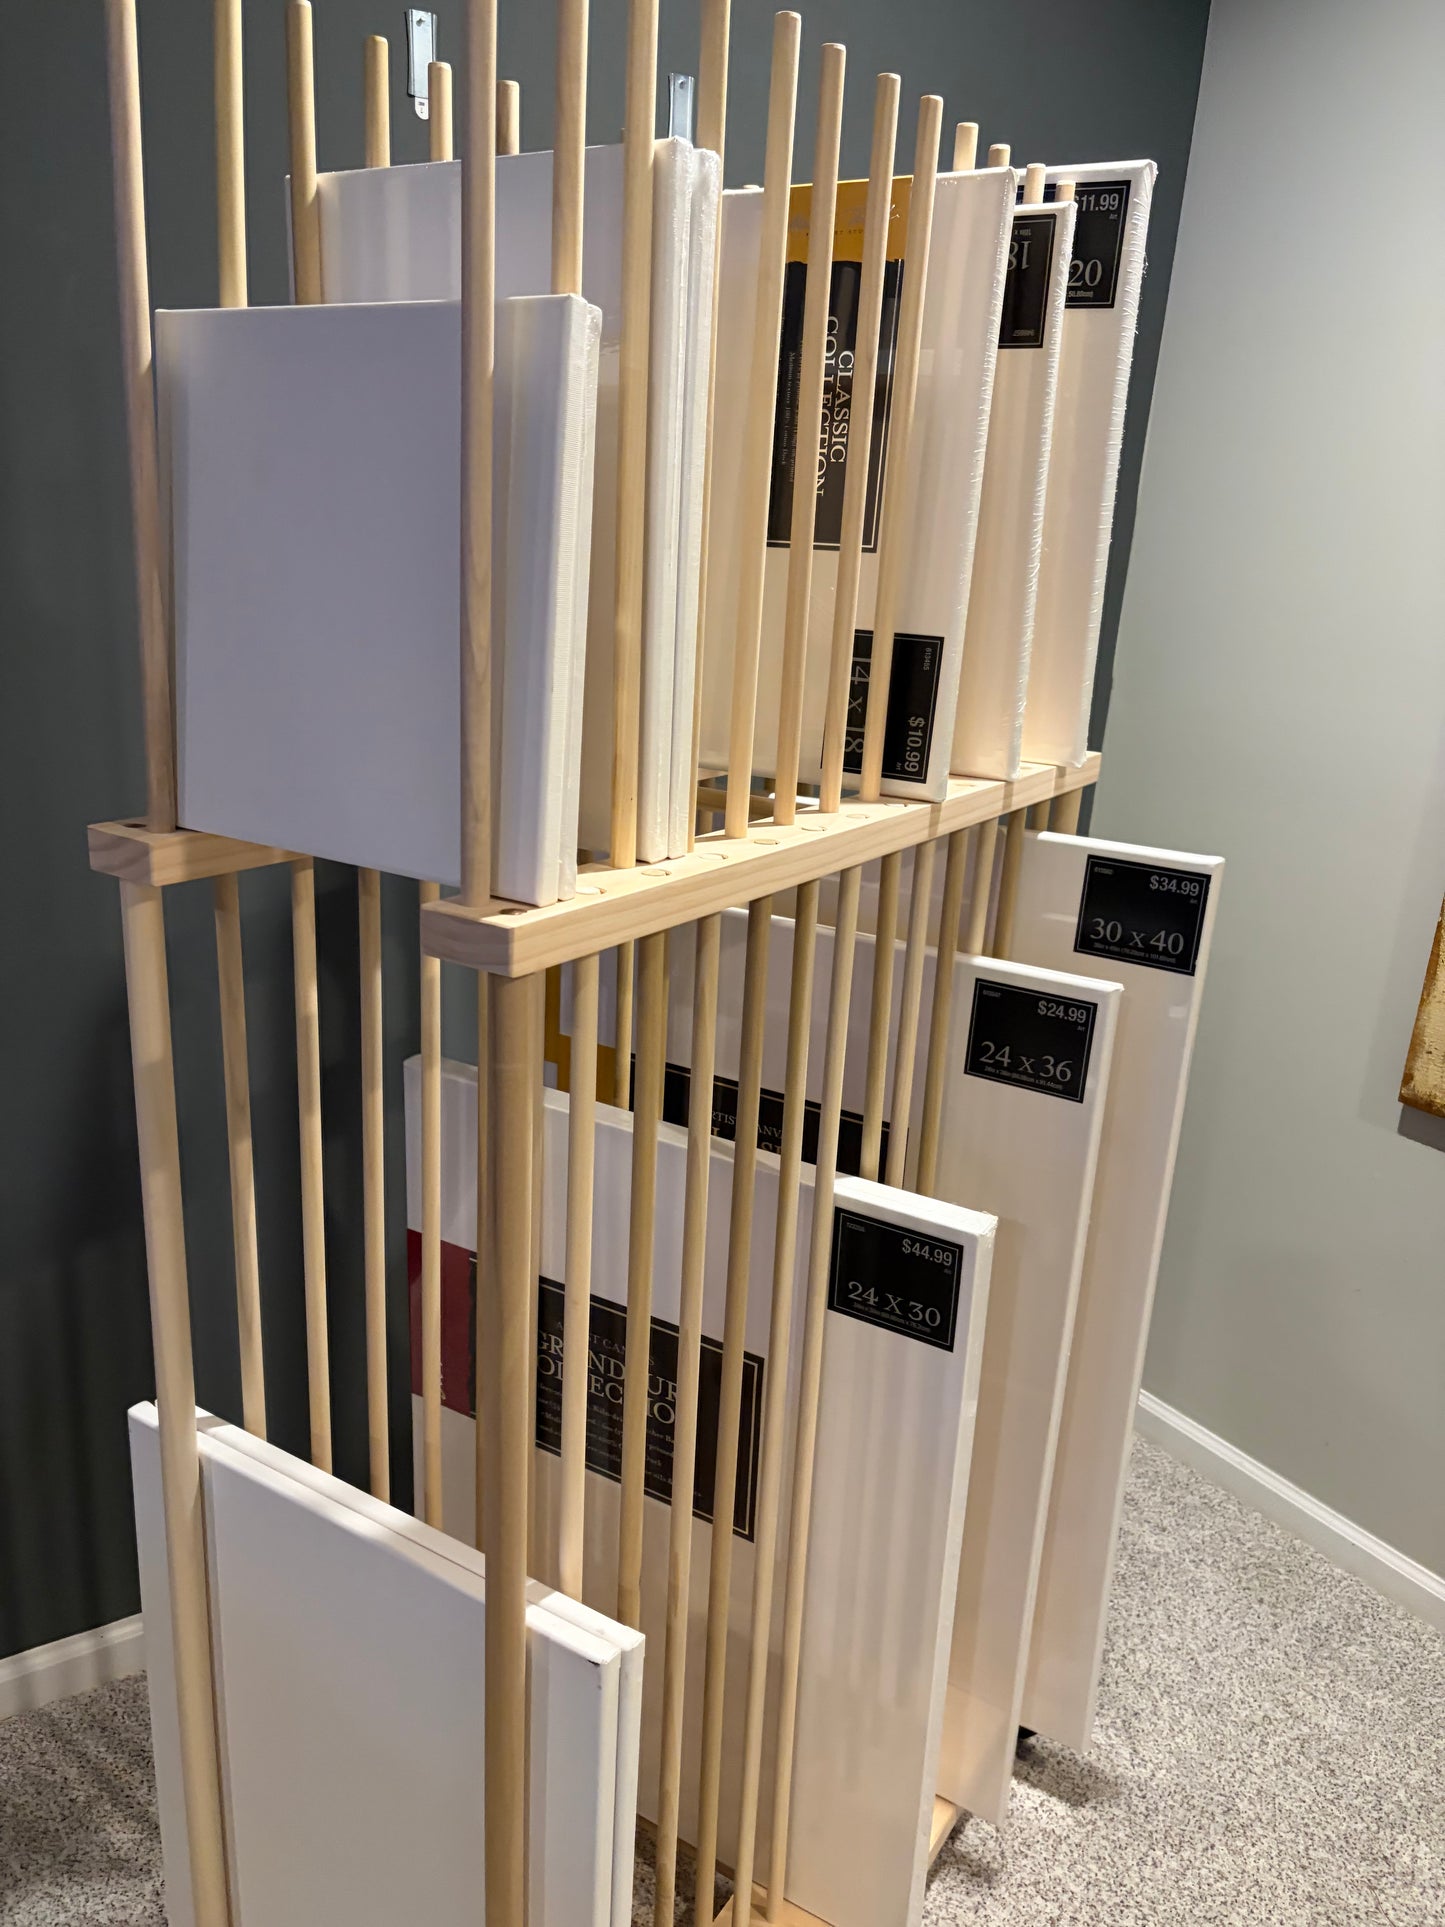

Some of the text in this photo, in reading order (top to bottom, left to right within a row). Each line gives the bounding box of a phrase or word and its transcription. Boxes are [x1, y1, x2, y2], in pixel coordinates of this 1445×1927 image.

[1074, 193, 1119, 212] 11.99
[1067, 259, 1103, 287] 20
[830, 350, 855, 463] CLASSIC
[904, 716, 926, 772] $10.99
[1149, 875, 1200, 897] $34.99
[1089, 918, 1122, 943] 30
[1149, 930, 1184, 955] 40
[1037, 1000, 1087, 1024] $24.99
[979, 1041, 1011, 1067] 24
[1040, 1055, 1073, 1082] 36
[901, 1238, 953, 1267] $44.99
[848, 1281, 879, 1306] 24
[907, 1301, 941, 1327] 30
